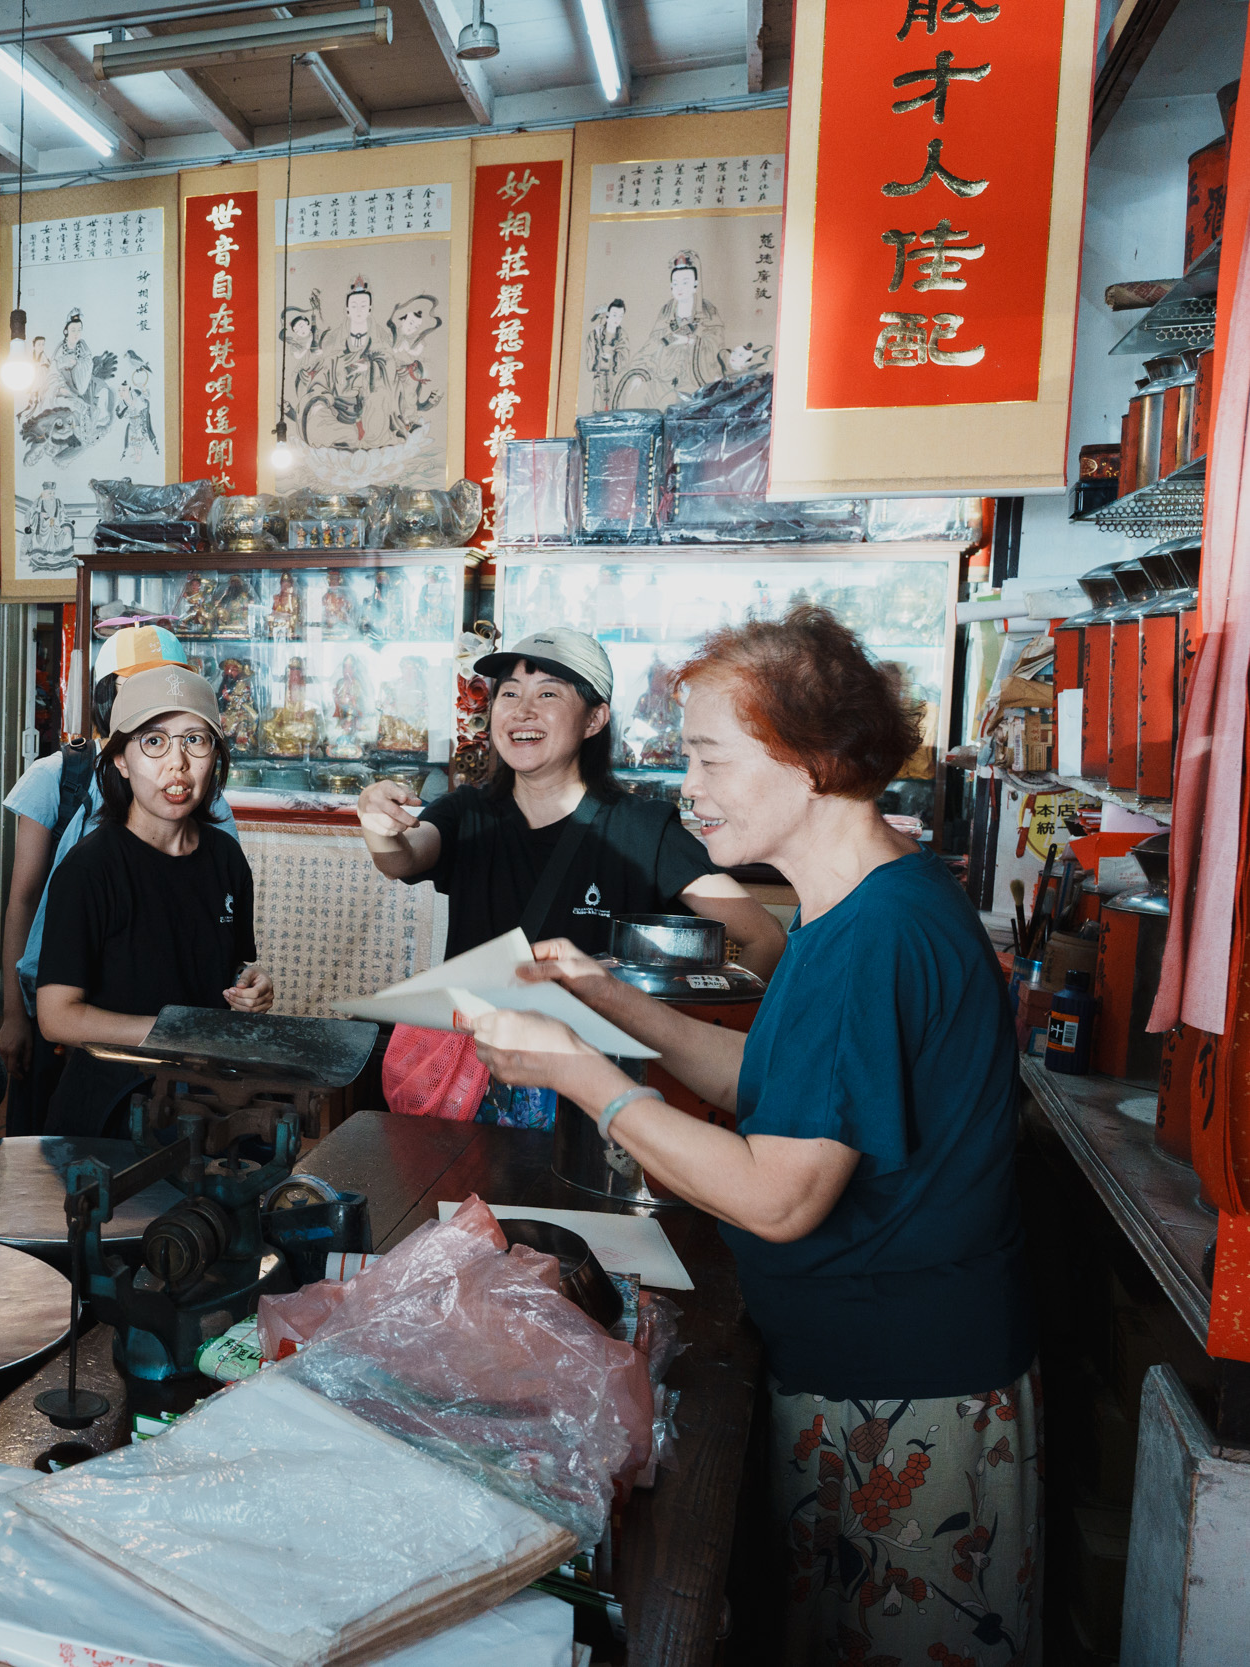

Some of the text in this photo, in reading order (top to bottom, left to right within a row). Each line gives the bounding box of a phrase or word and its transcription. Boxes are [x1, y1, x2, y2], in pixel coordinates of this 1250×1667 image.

[481, 168, 540, 556] 妙相莊嚴慈雲常護
